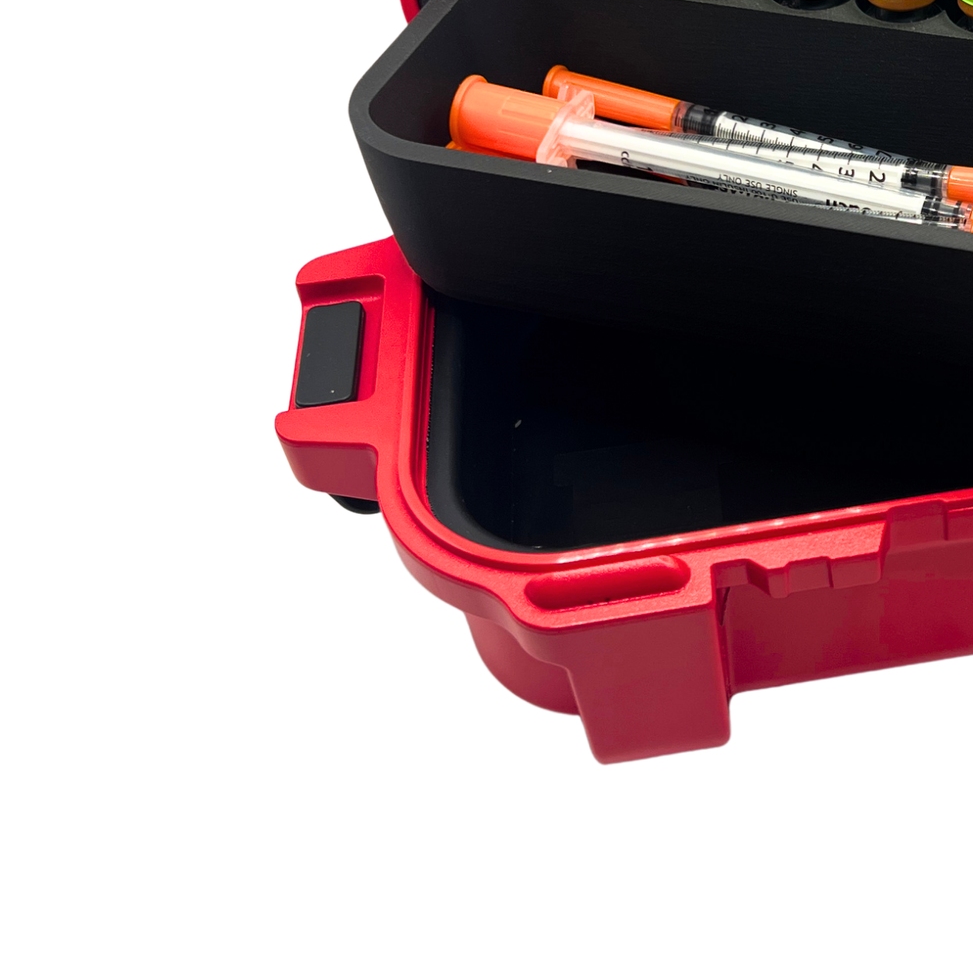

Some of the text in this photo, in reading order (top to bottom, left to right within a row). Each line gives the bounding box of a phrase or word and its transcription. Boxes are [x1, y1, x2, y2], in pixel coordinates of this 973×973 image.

[838, 166, 855, 178] 3
[868, 169, 886, 184] 2
[717, 173, 742, 186] ONLY
[744, 178, 762, 190] USE
[765, 183, 798, 198] SINGLE
